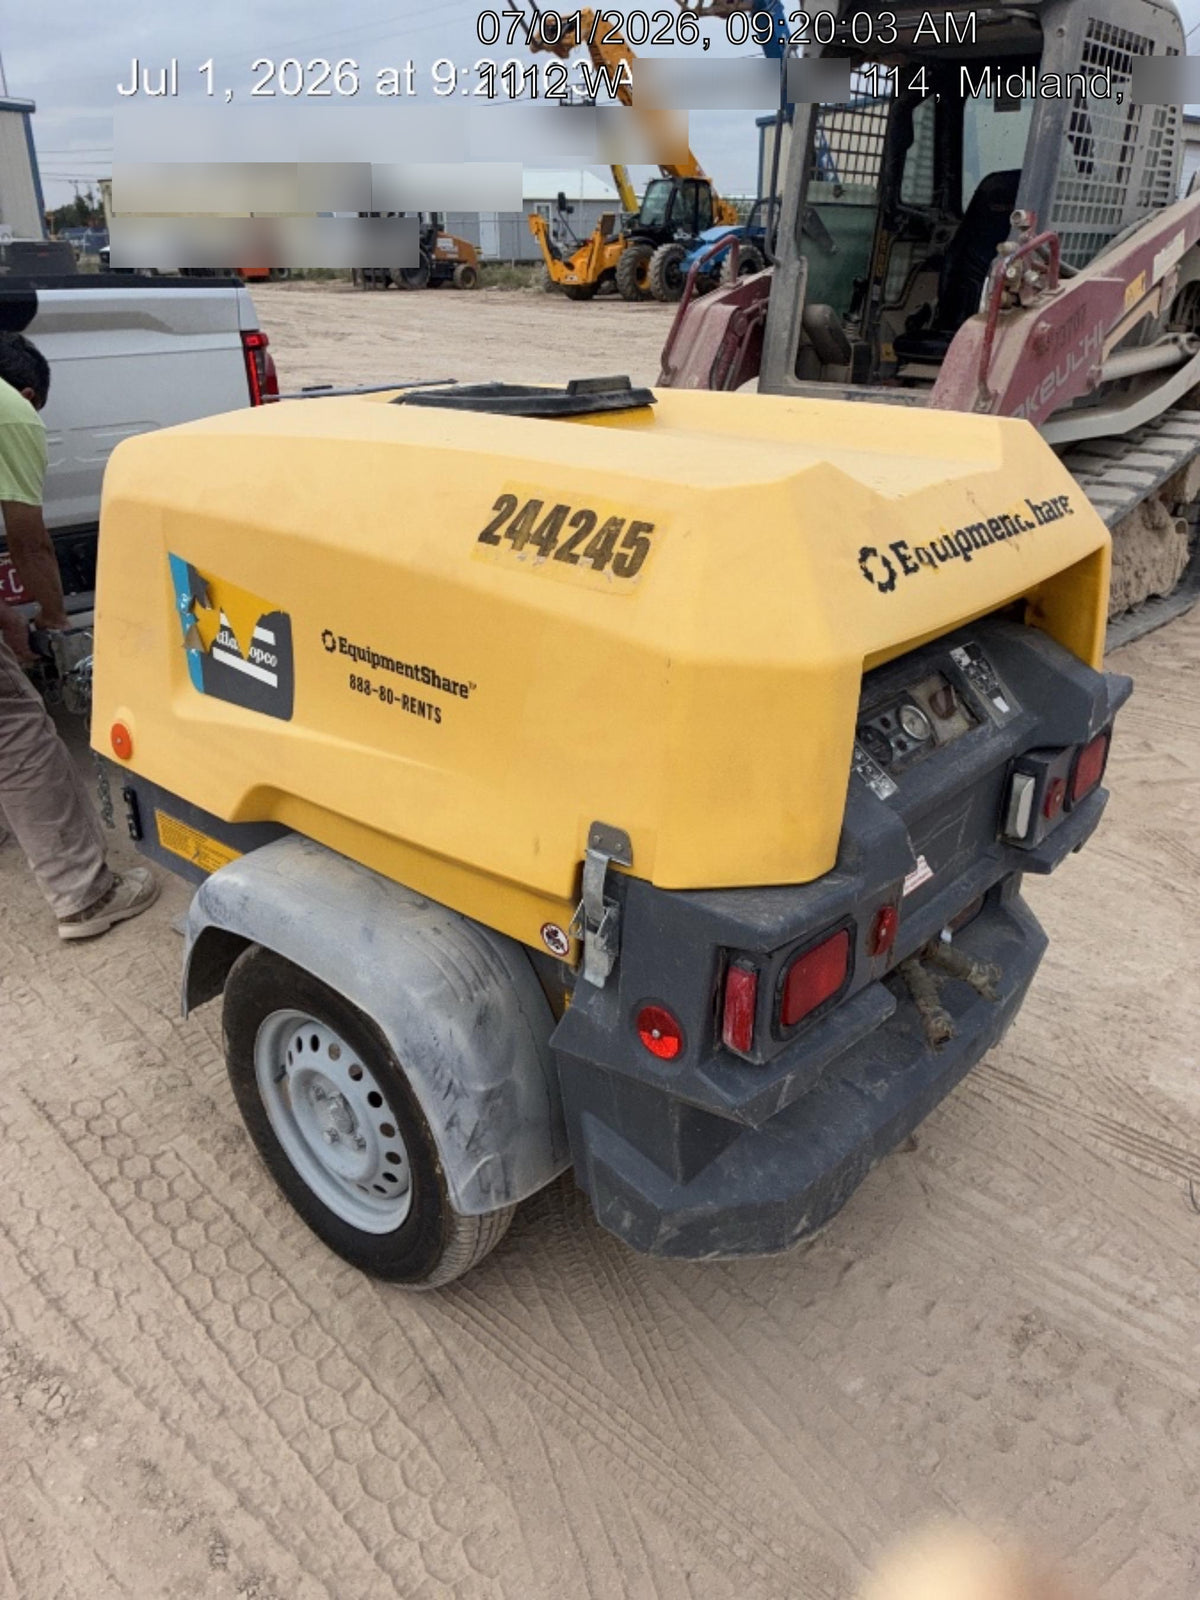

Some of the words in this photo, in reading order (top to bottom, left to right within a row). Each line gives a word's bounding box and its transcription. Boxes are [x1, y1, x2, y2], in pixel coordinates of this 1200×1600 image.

[478, 493, 655, 578] 244245
[338, 636, 470, 699] EquipmentShare
[349, 673, 442, 724] 888-80-RENTS
